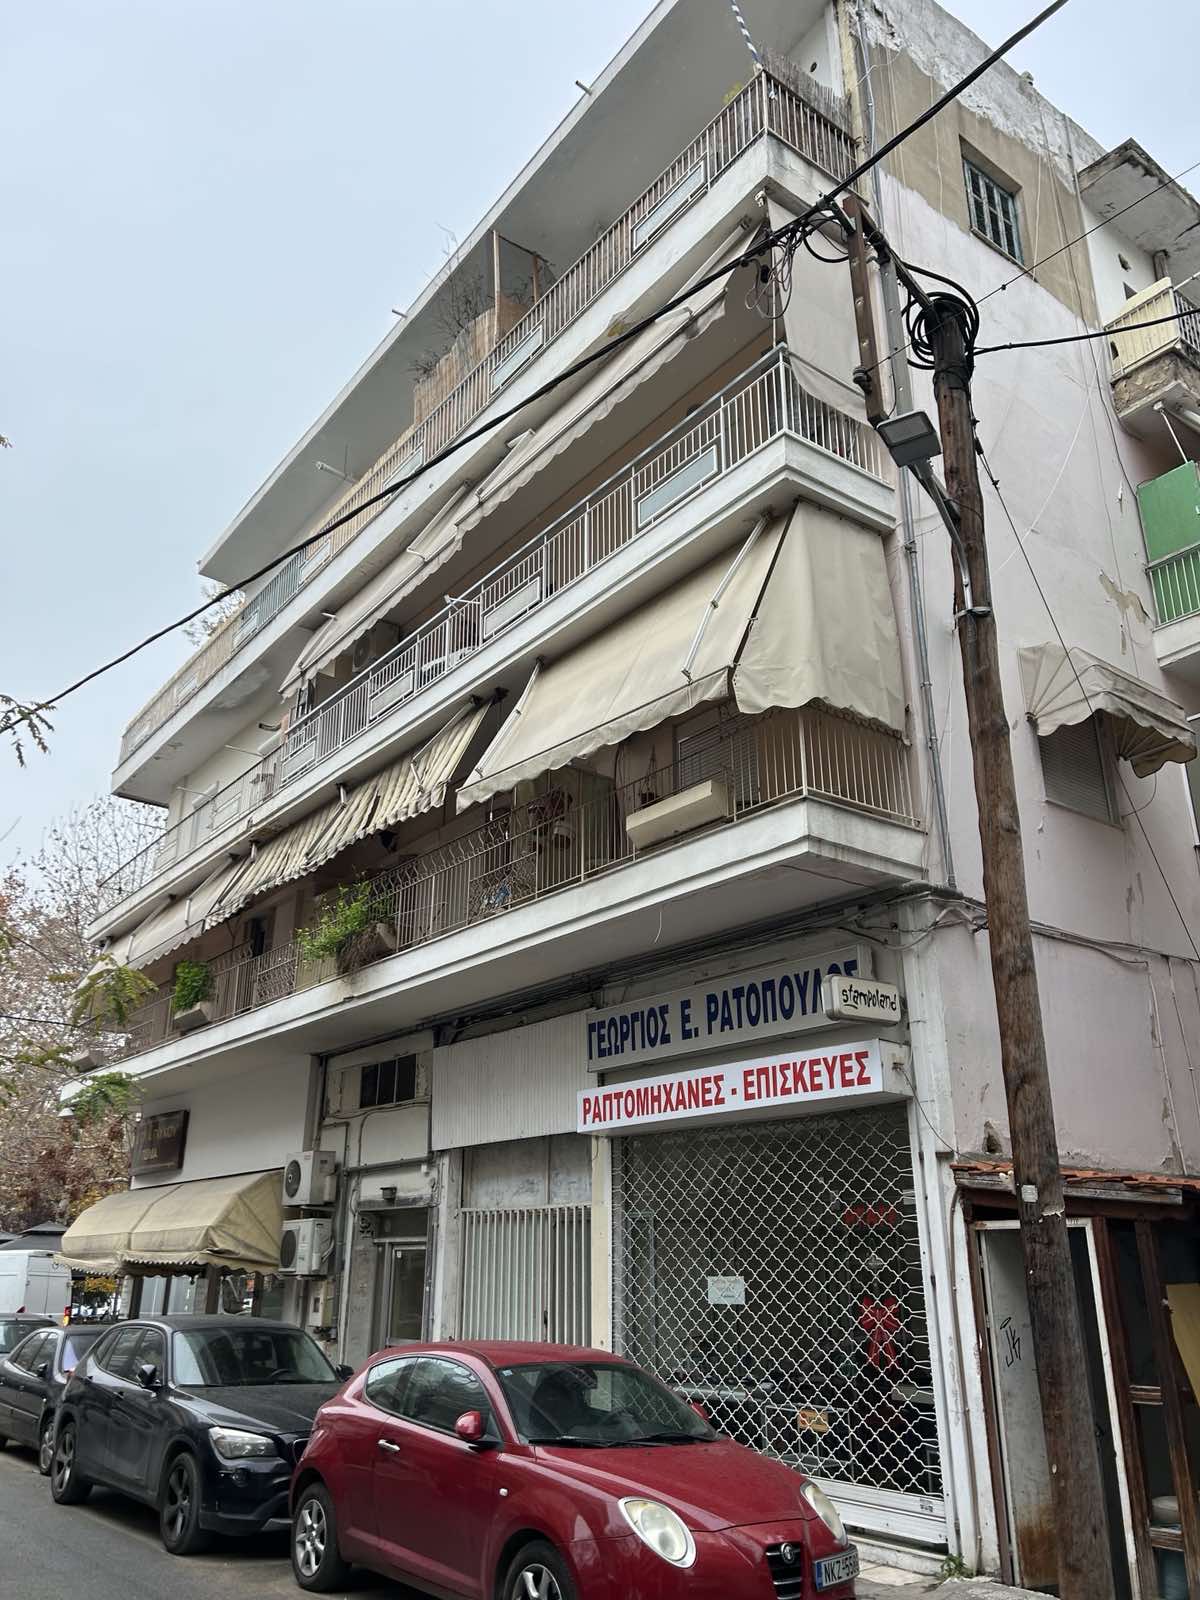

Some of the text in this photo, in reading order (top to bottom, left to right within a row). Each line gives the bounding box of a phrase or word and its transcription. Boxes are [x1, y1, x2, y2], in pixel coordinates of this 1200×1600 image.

[842, 984, 896, 1011] stampoland
[588, 1004, 671, 1060] ΓΕΩΡΓΙΟΣ
[680, 999, 699, 1041] Ε.
[582, 1074, 726, 1126] ΡΑΠΤΟΜΗΧΑΝΕΣ
[743, 1051, 872, 1102] ΕΠΙΣΚΕΥΕΣ
